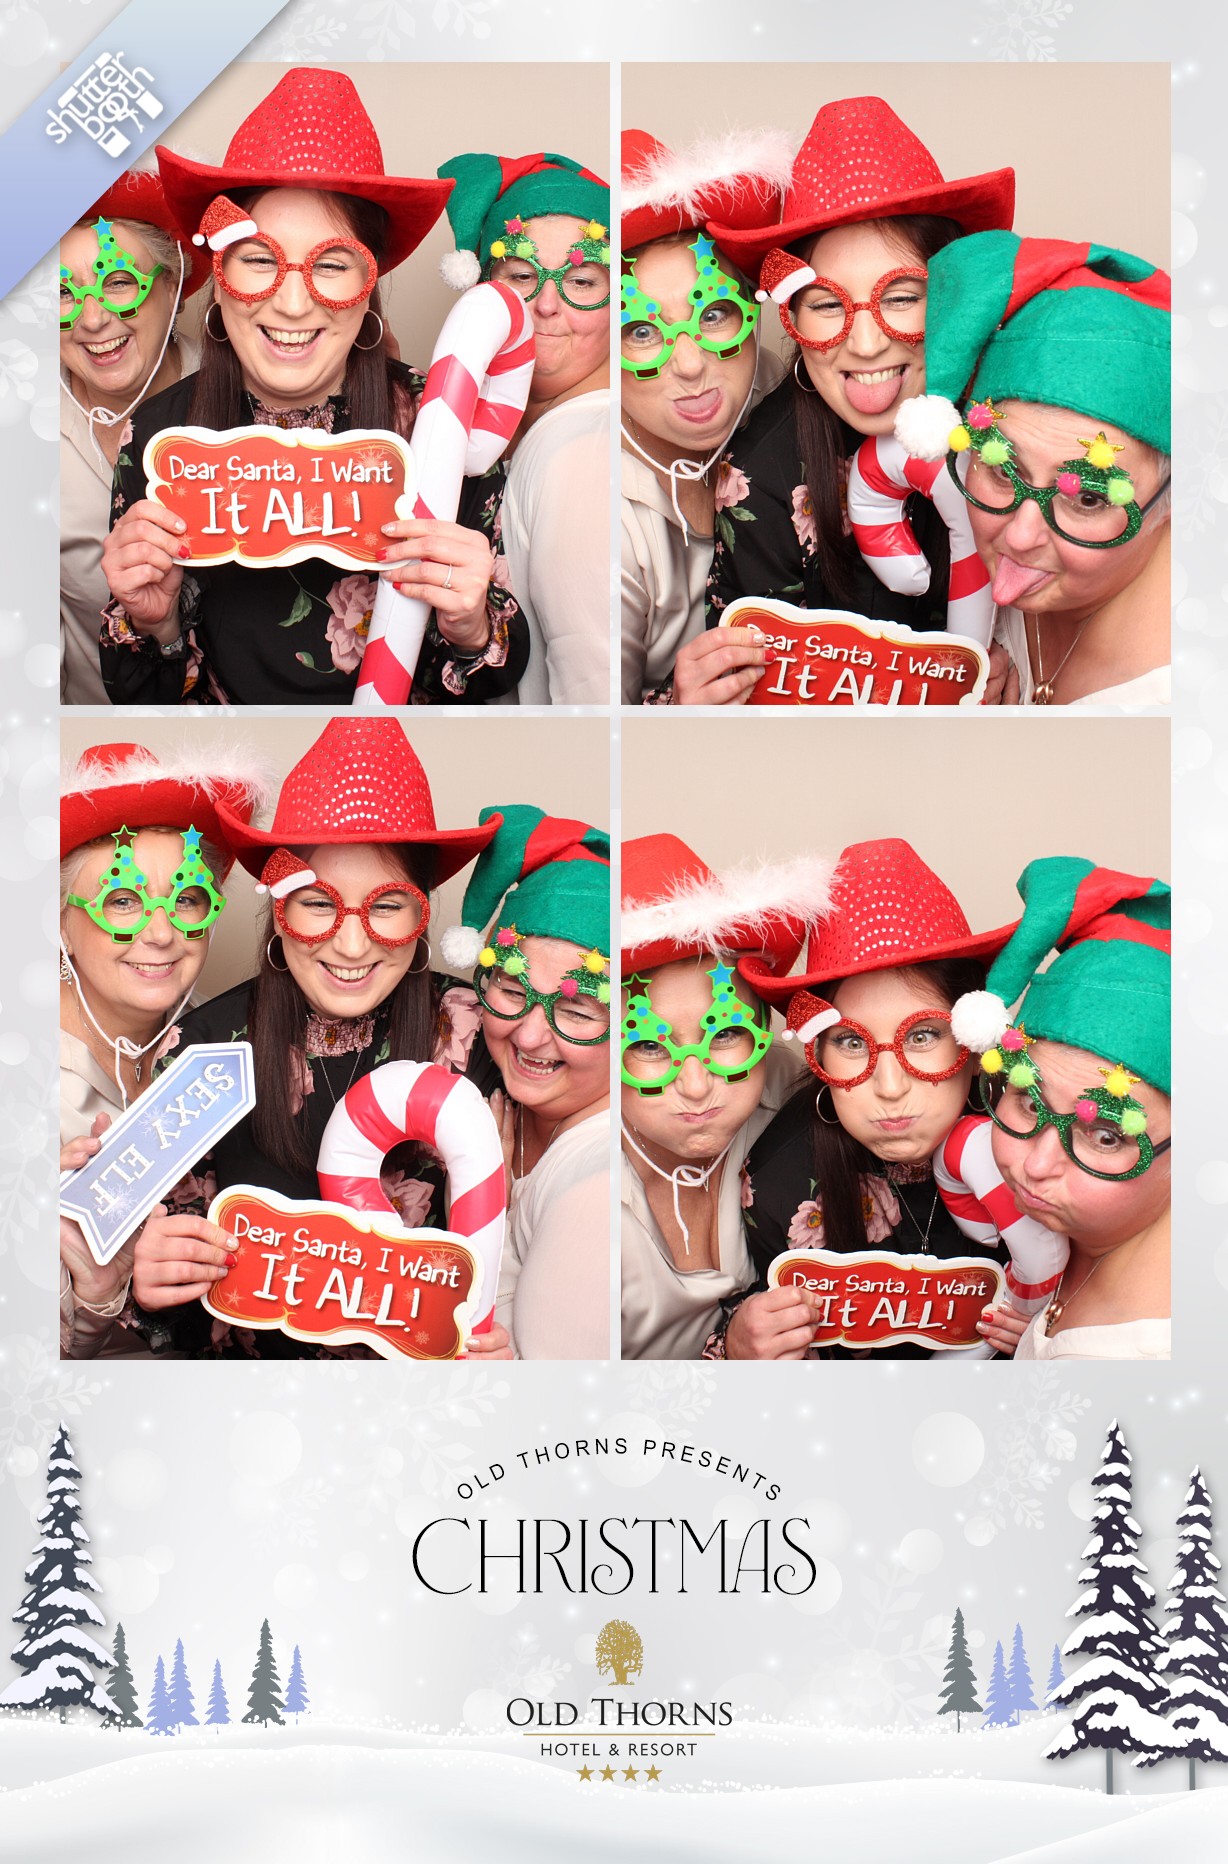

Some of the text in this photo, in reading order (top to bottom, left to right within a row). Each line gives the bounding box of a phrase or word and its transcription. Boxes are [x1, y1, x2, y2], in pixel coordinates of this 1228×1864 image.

[168, 455, 393, 484] Dear Santa, I Want
[200, 487, 362, 537] It ALL!
[767, 656, 817, 699] It
[805, 635, 878, 669] Santa,
[886, 650, 903, 671] I
[908, 656, 967, 683] Want
[90, 1063, 235, 1216] SEXY ELF
[234, 1213, 461, 1288] Dear Santa, I Want
[252, 1253, 420, 1332] It ALL!
[792, 1272, 988, 1297] Dear Santa, I Want
[818, 1295, 954, 1330] It ALL!
